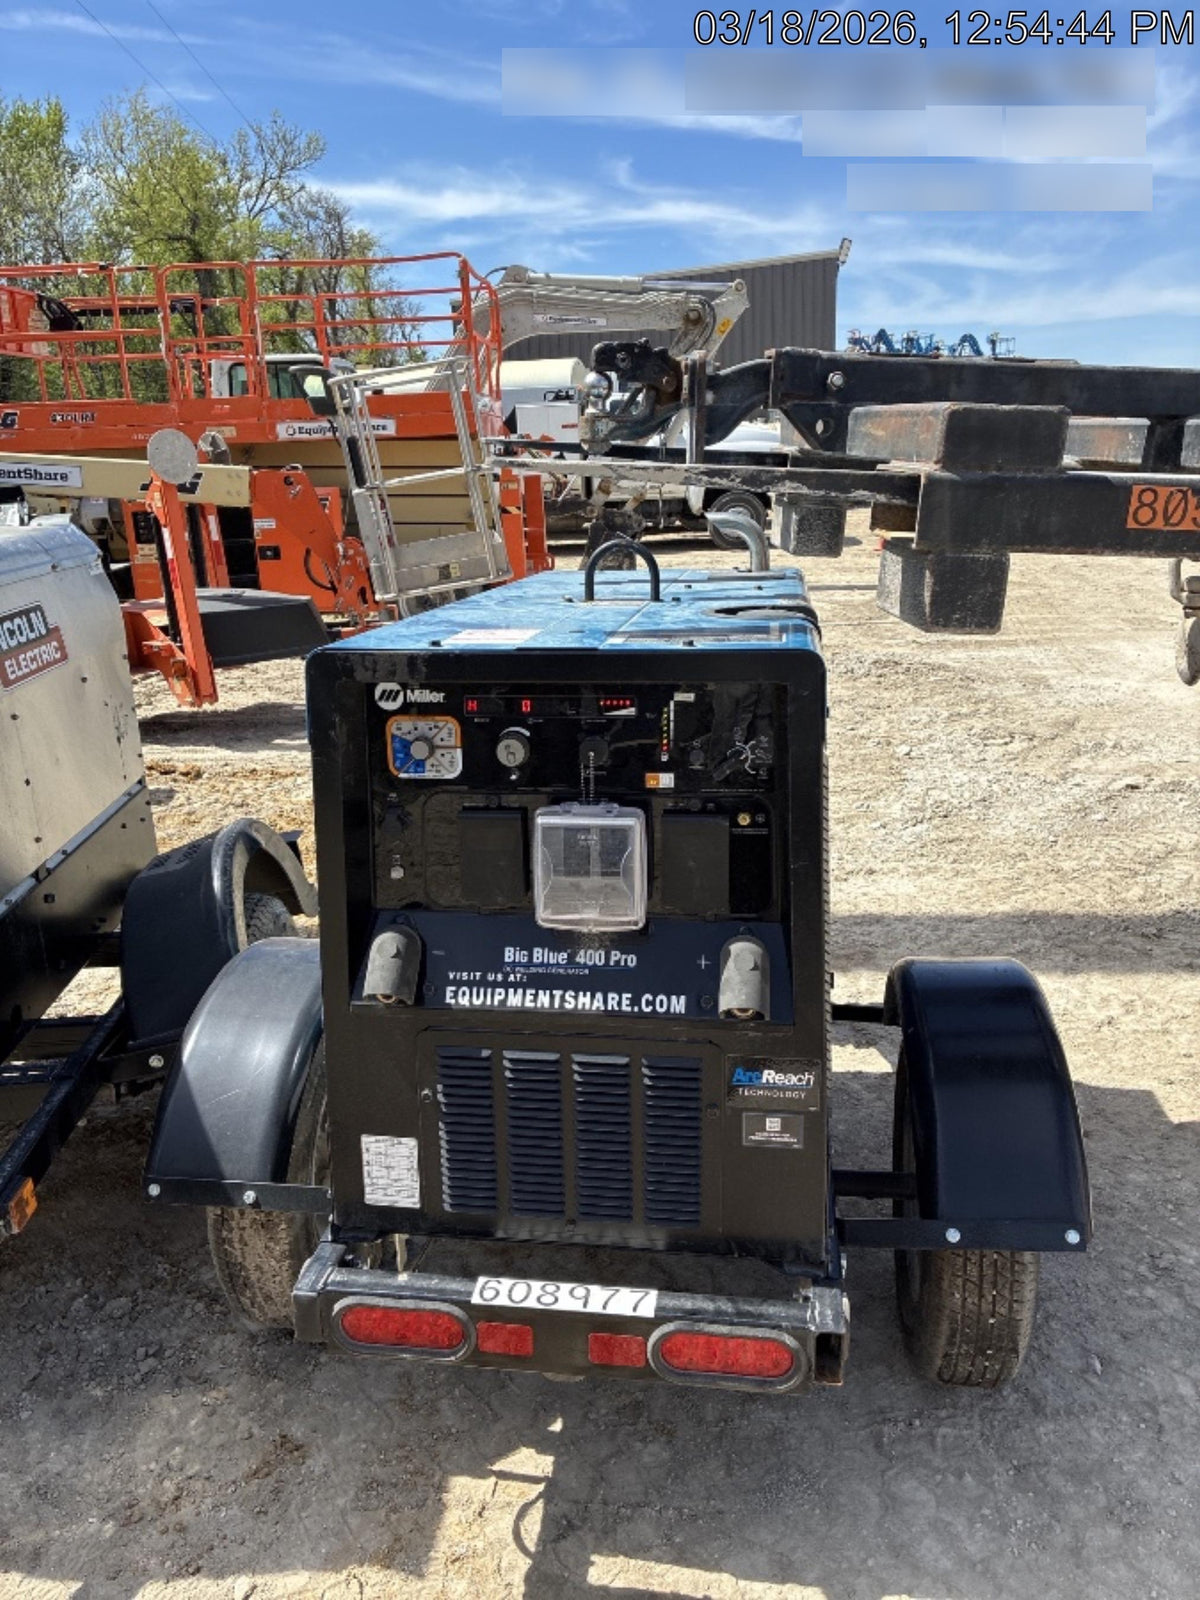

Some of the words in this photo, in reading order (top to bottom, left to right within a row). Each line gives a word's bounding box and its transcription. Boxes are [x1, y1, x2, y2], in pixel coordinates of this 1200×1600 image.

[4, 641, 61, 680] ELECTRIC
[406, 689, 446, 703] Miller
[504, 947, 528, 963] Big
[533, 947, 567, 964] Blue
[576, 949, 605, 966] 400
[609, 950, 637, 968] Pro
[448, 971, 481, 981] VISIT
[487, 972, 503, 982] US
[508, 973, 527, 983] AT:
[445, 986, 687, 1015] EQUIPMENTSHARE.COM
[732, 1067, 815, 1087] ArcReach
[738, 1088, 807, 1099] TECHNOLOGY
[479, 1279, 651, 1313] 608977
